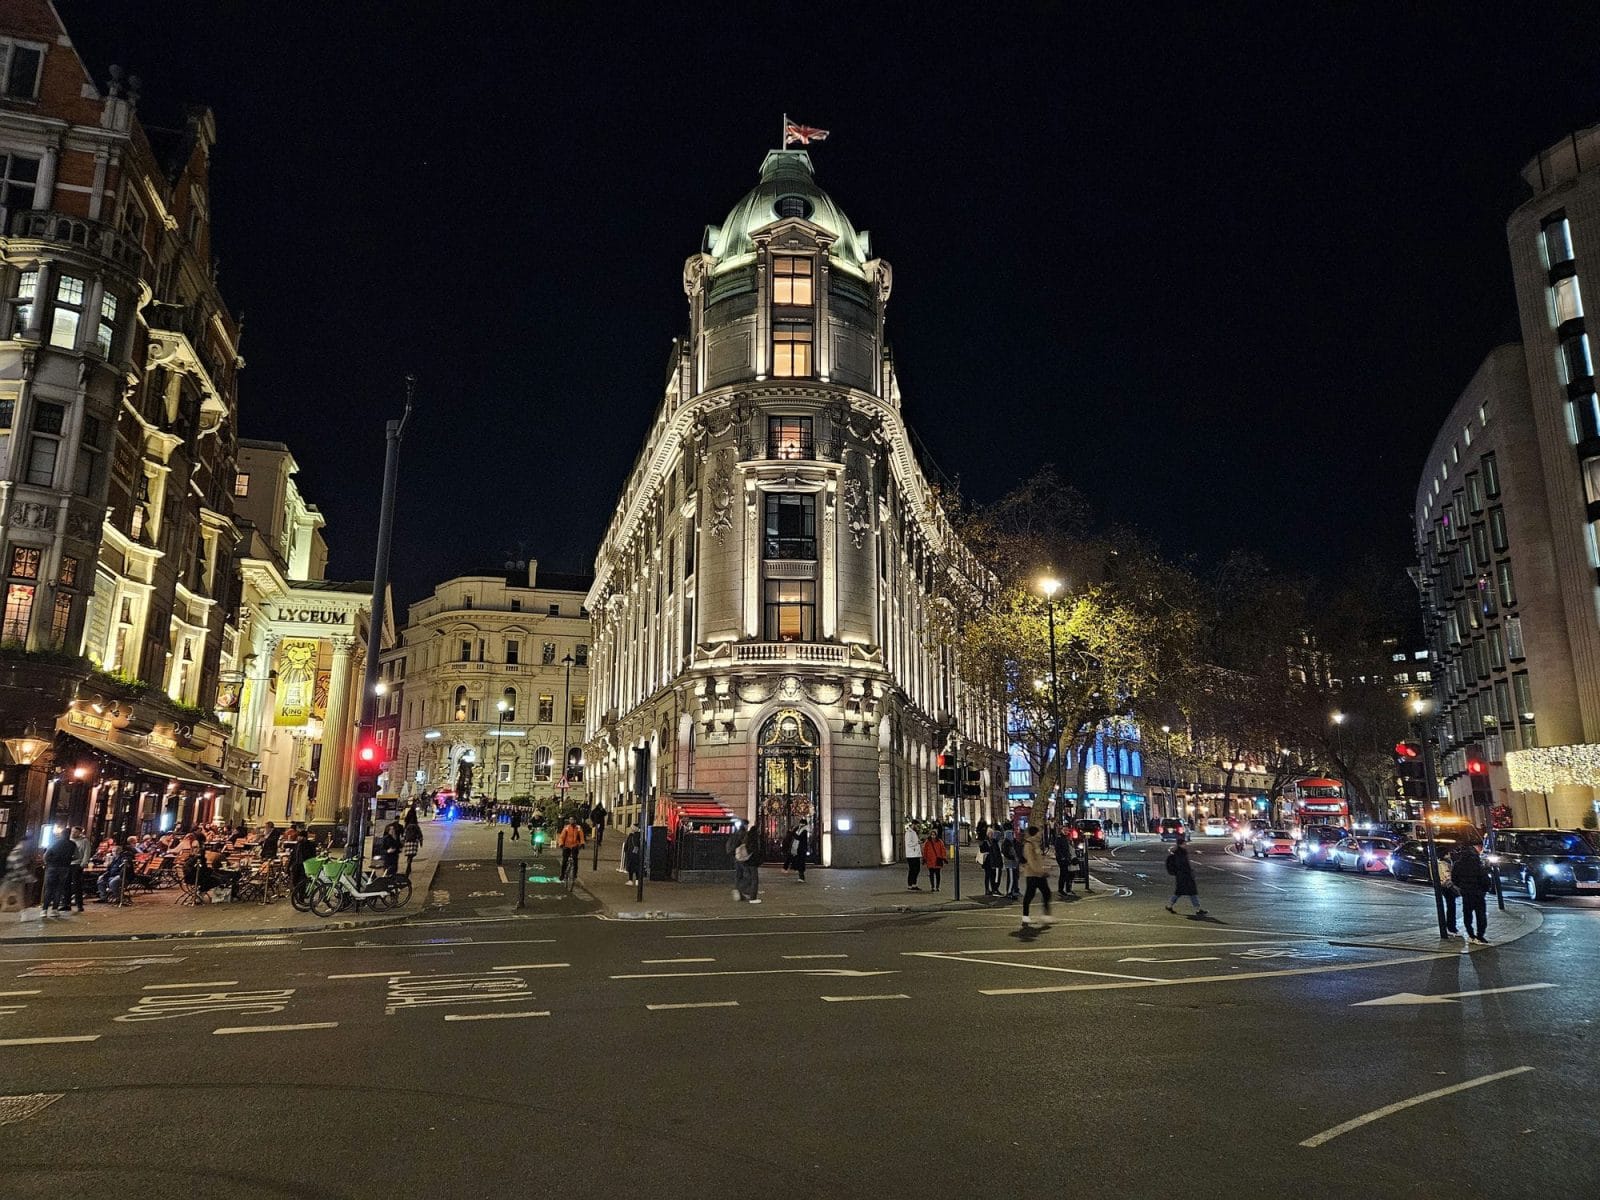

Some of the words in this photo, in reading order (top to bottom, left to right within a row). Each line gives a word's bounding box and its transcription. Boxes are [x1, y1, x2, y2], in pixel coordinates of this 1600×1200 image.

[278, 608, 346, 624] LYCEUM
[282, 707, 302, 717] KING
[113, 988, 296, 1022] BUS
[385, 970, 536, 1015] LOCAL
